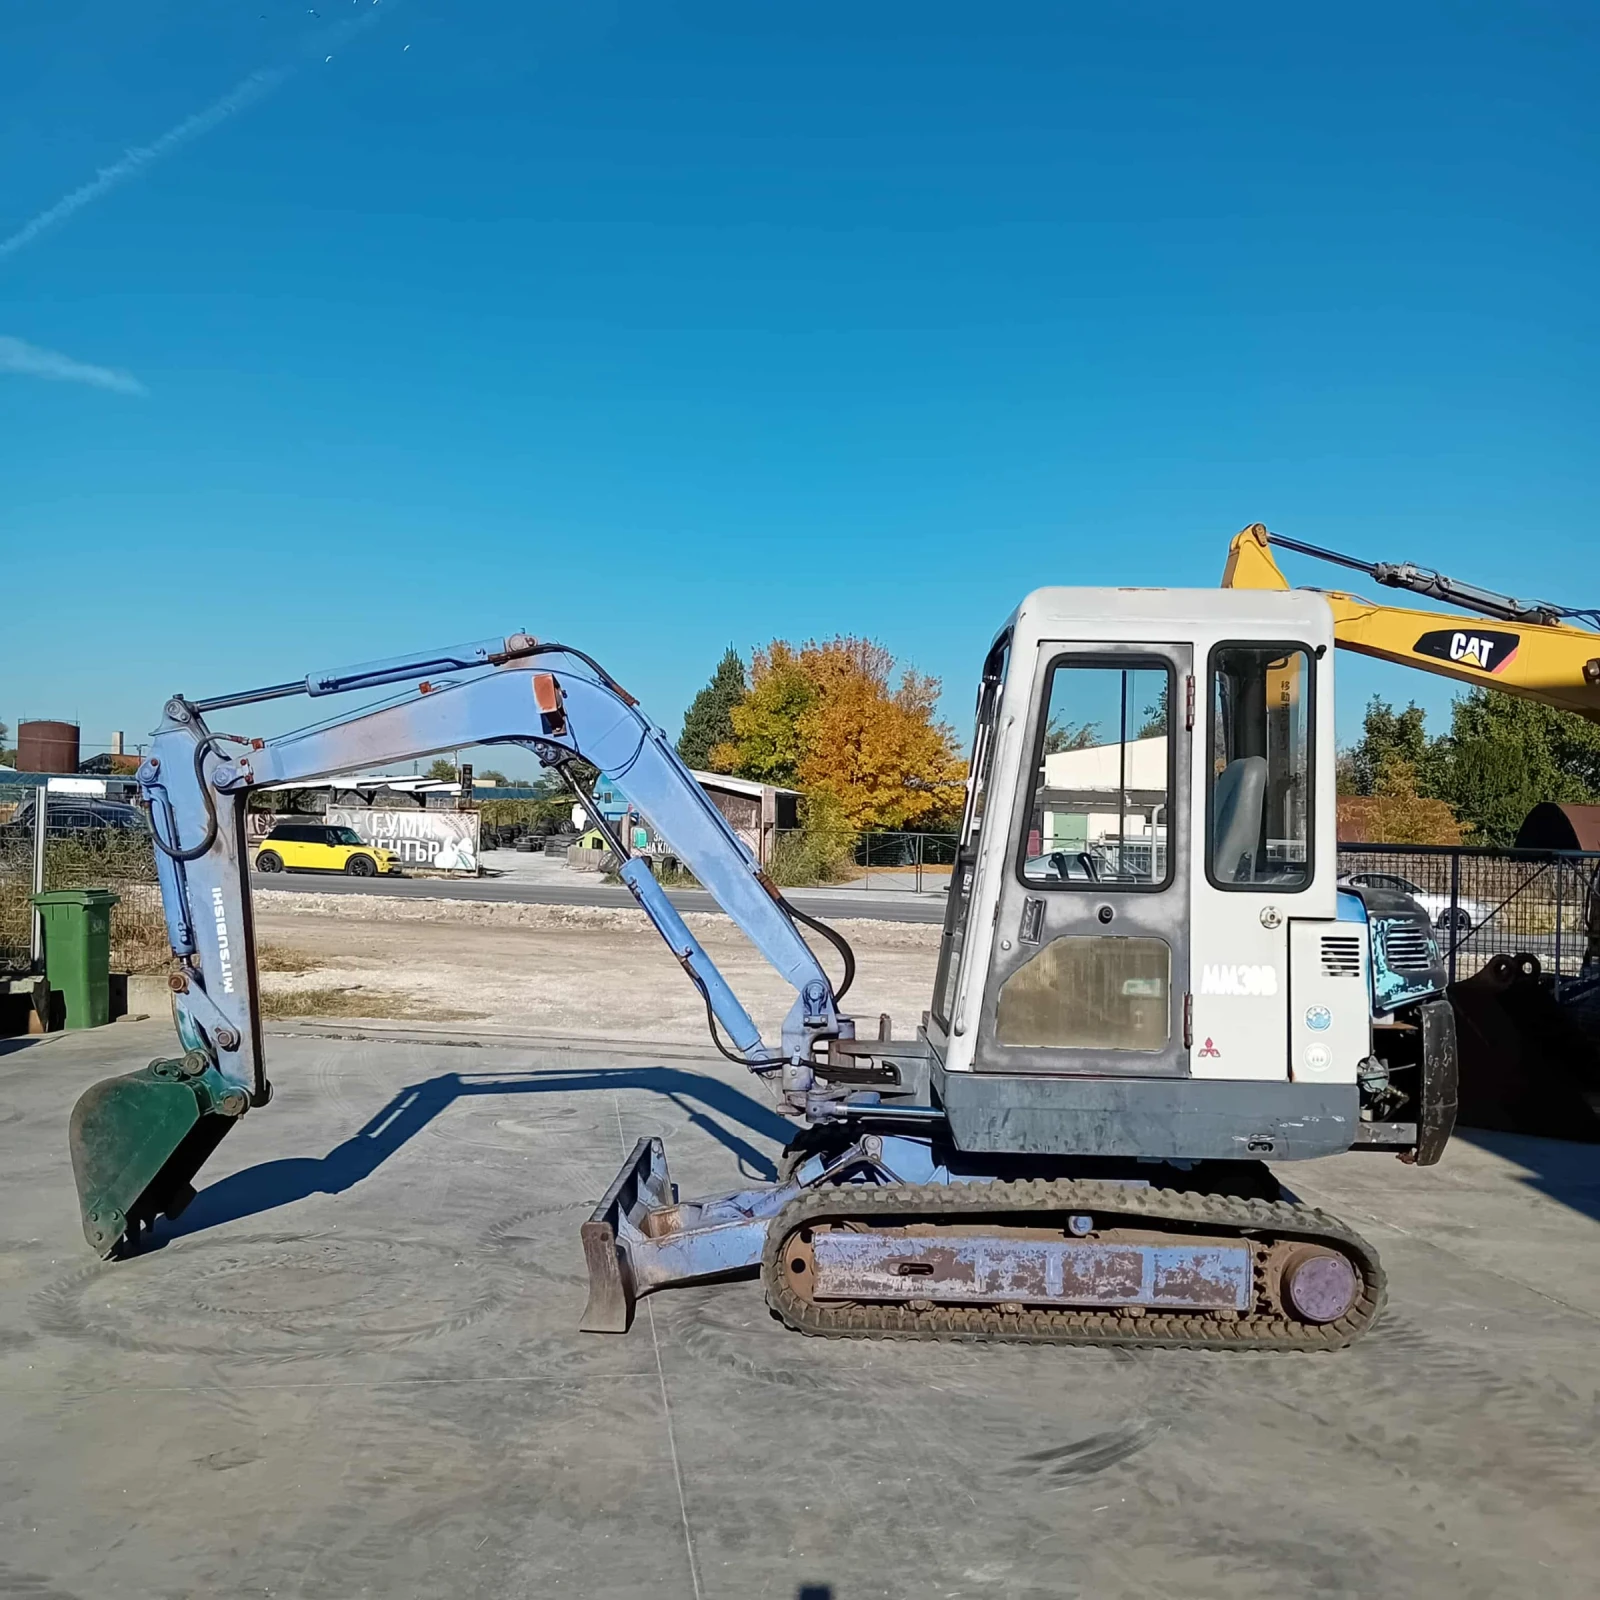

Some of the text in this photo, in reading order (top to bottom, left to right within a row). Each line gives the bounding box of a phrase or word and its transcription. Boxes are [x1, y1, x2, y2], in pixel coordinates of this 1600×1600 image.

[1449, 632, 1494, 669] CAT
[372, 812, 432, 838] ГУМИ
[211, 886, 234, 993] MITSUBISHI
